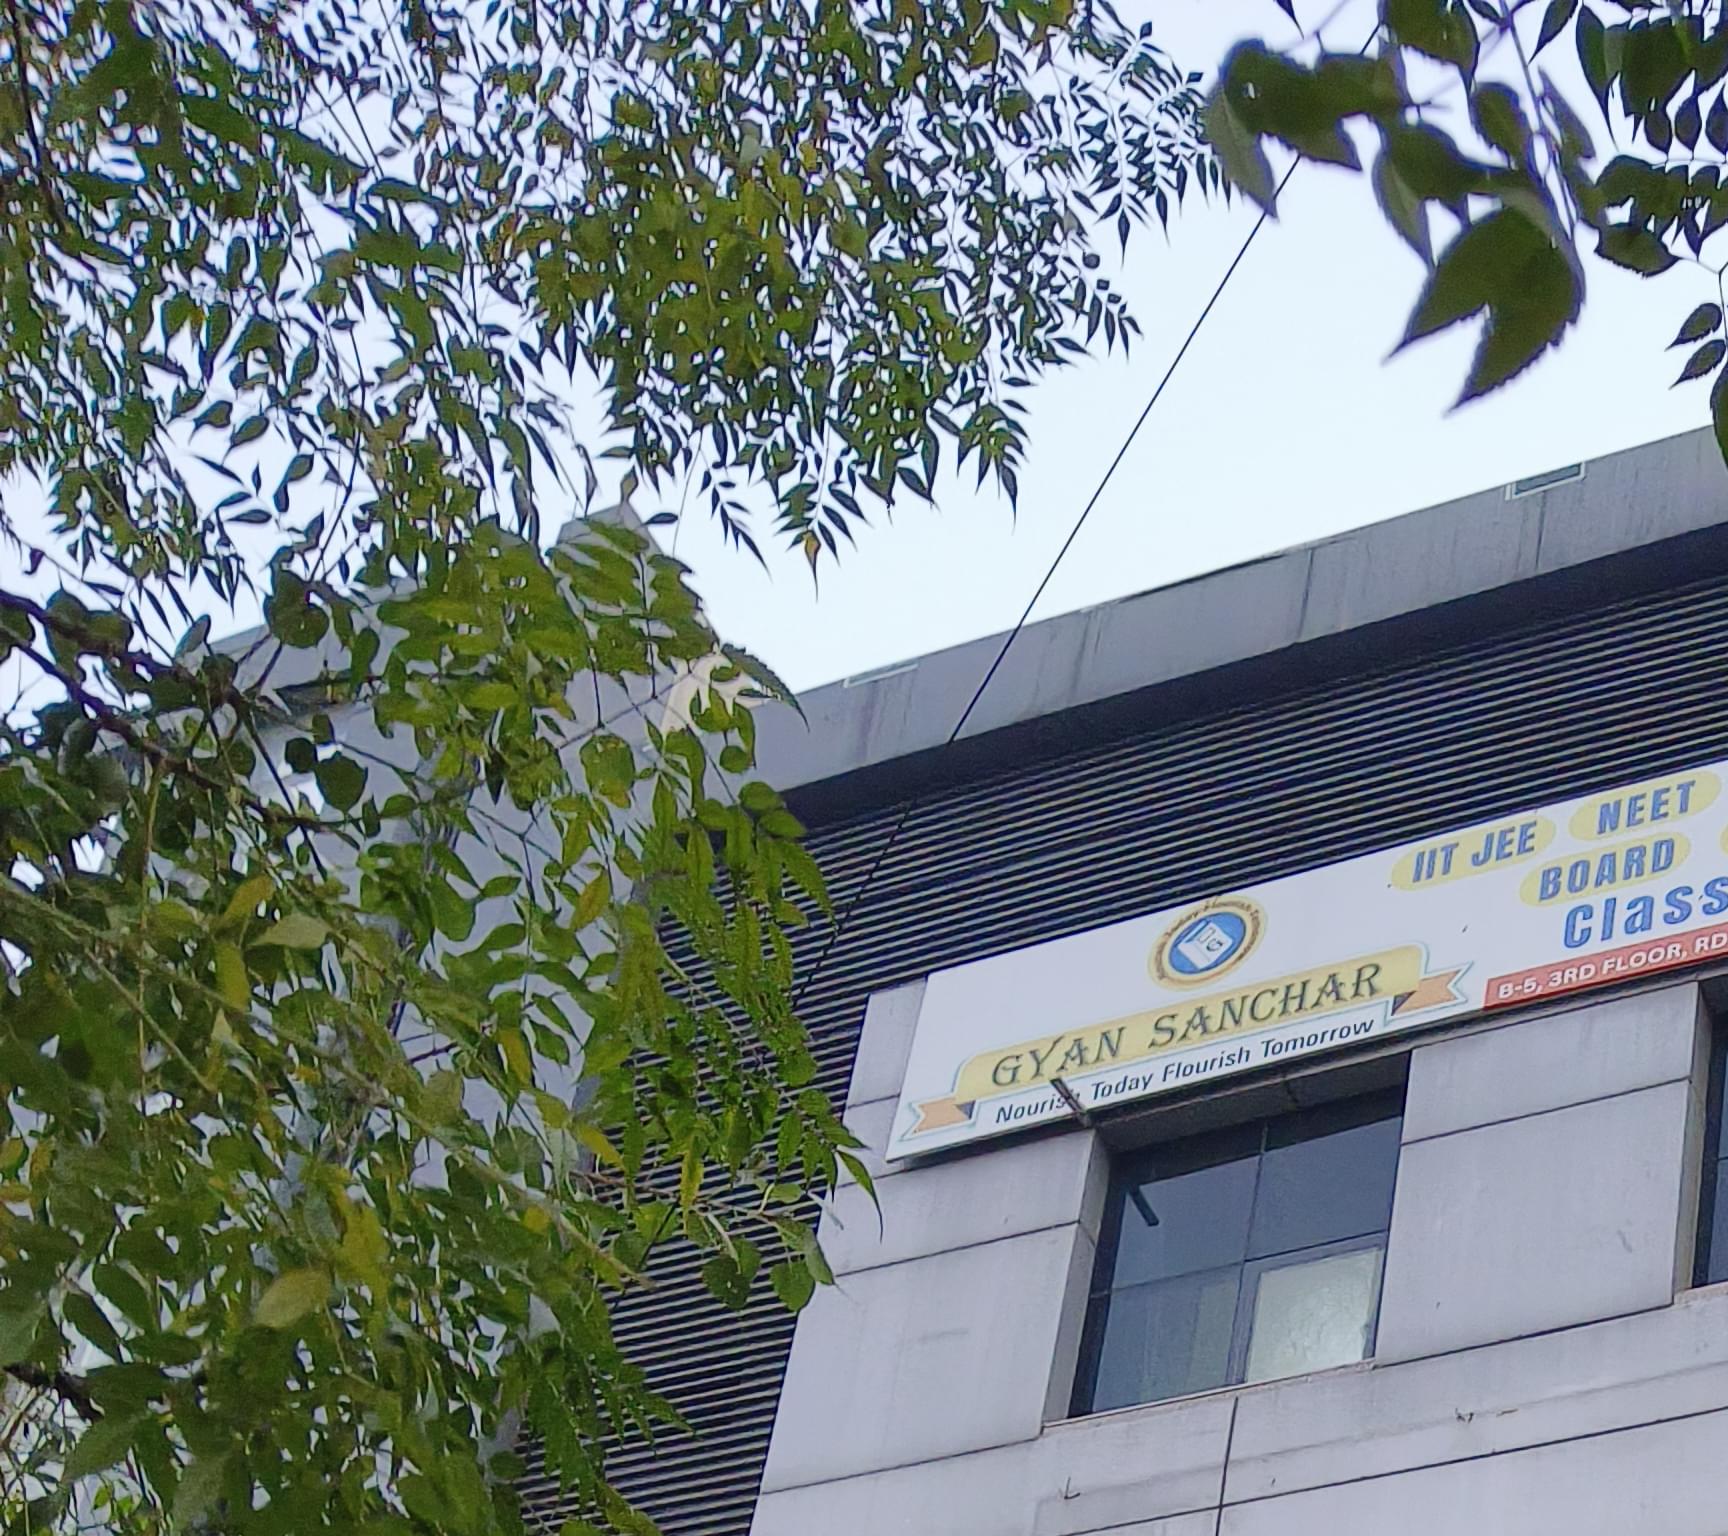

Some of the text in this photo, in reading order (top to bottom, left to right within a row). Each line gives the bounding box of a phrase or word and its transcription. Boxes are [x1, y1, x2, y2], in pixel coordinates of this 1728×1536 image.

[1412, 841, 1459, 884] IIT
[1470, 820, 1536, 869] JEE
[1597, 778, 1697, 836] NEET
[1537, 837, 1676, 903] BOARD
[1498, 975, 1545, 999] B-5,
[1549, 963, 1596, 989] 3RD
[1602, 943, 1688, 976] FLOOR,
[991, 961, 1383, 1088] GYAN SANCHAR
[1091, 1070, 1154, 1100] Today
[1162, 1046, 1250, 1083] Flourish
[1260, 1019, 1374, 1057] Tomorrow
